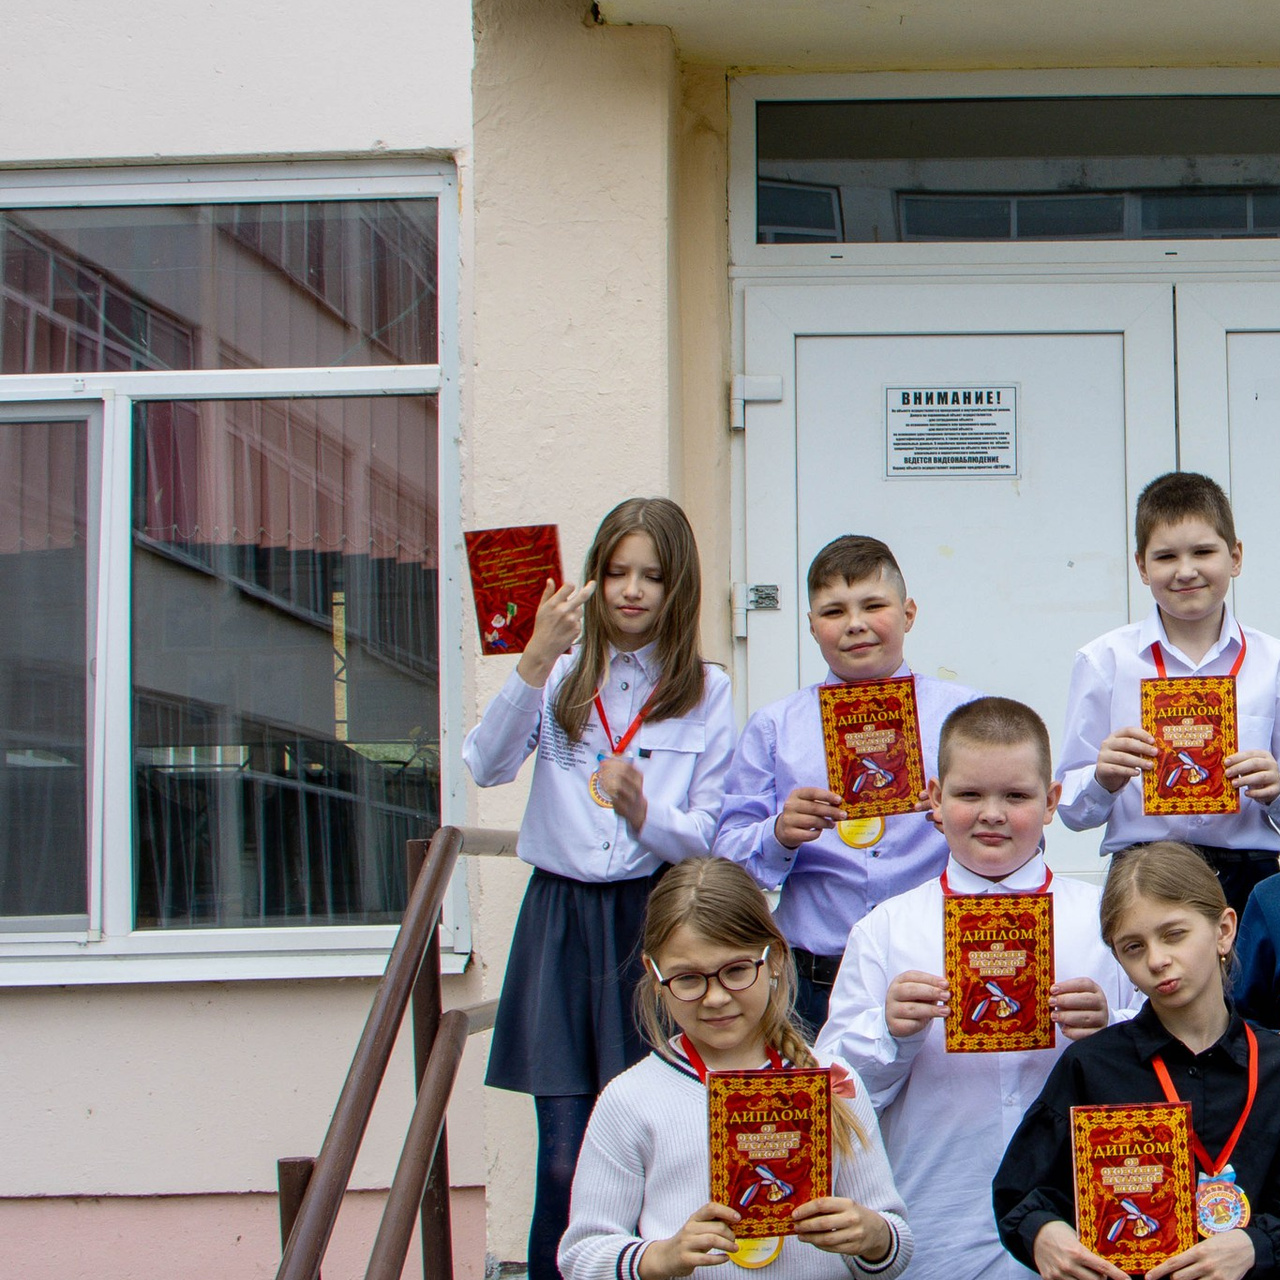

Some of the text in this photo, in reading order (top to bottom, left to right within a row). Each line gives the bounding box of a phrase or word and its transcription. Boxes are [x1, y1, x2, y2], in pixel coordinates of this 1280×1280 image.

[902, 391, 1001, 405] ВНИМАНИЕ!
[933, 456, 999, 464] ВИДЕОНАБЛЮДЕНИЕ
[839, 710, 900, 726] ДИПЛОМ
[1158, 706, 1219, 718] ДИПЛОМ
[963, 929, 1033, 943] ДИПЛОМ
[730, 1109, 809, 1124] ДИПЛОМ
[1094, 1142, 1171, 1159] ДИПЛОМ
